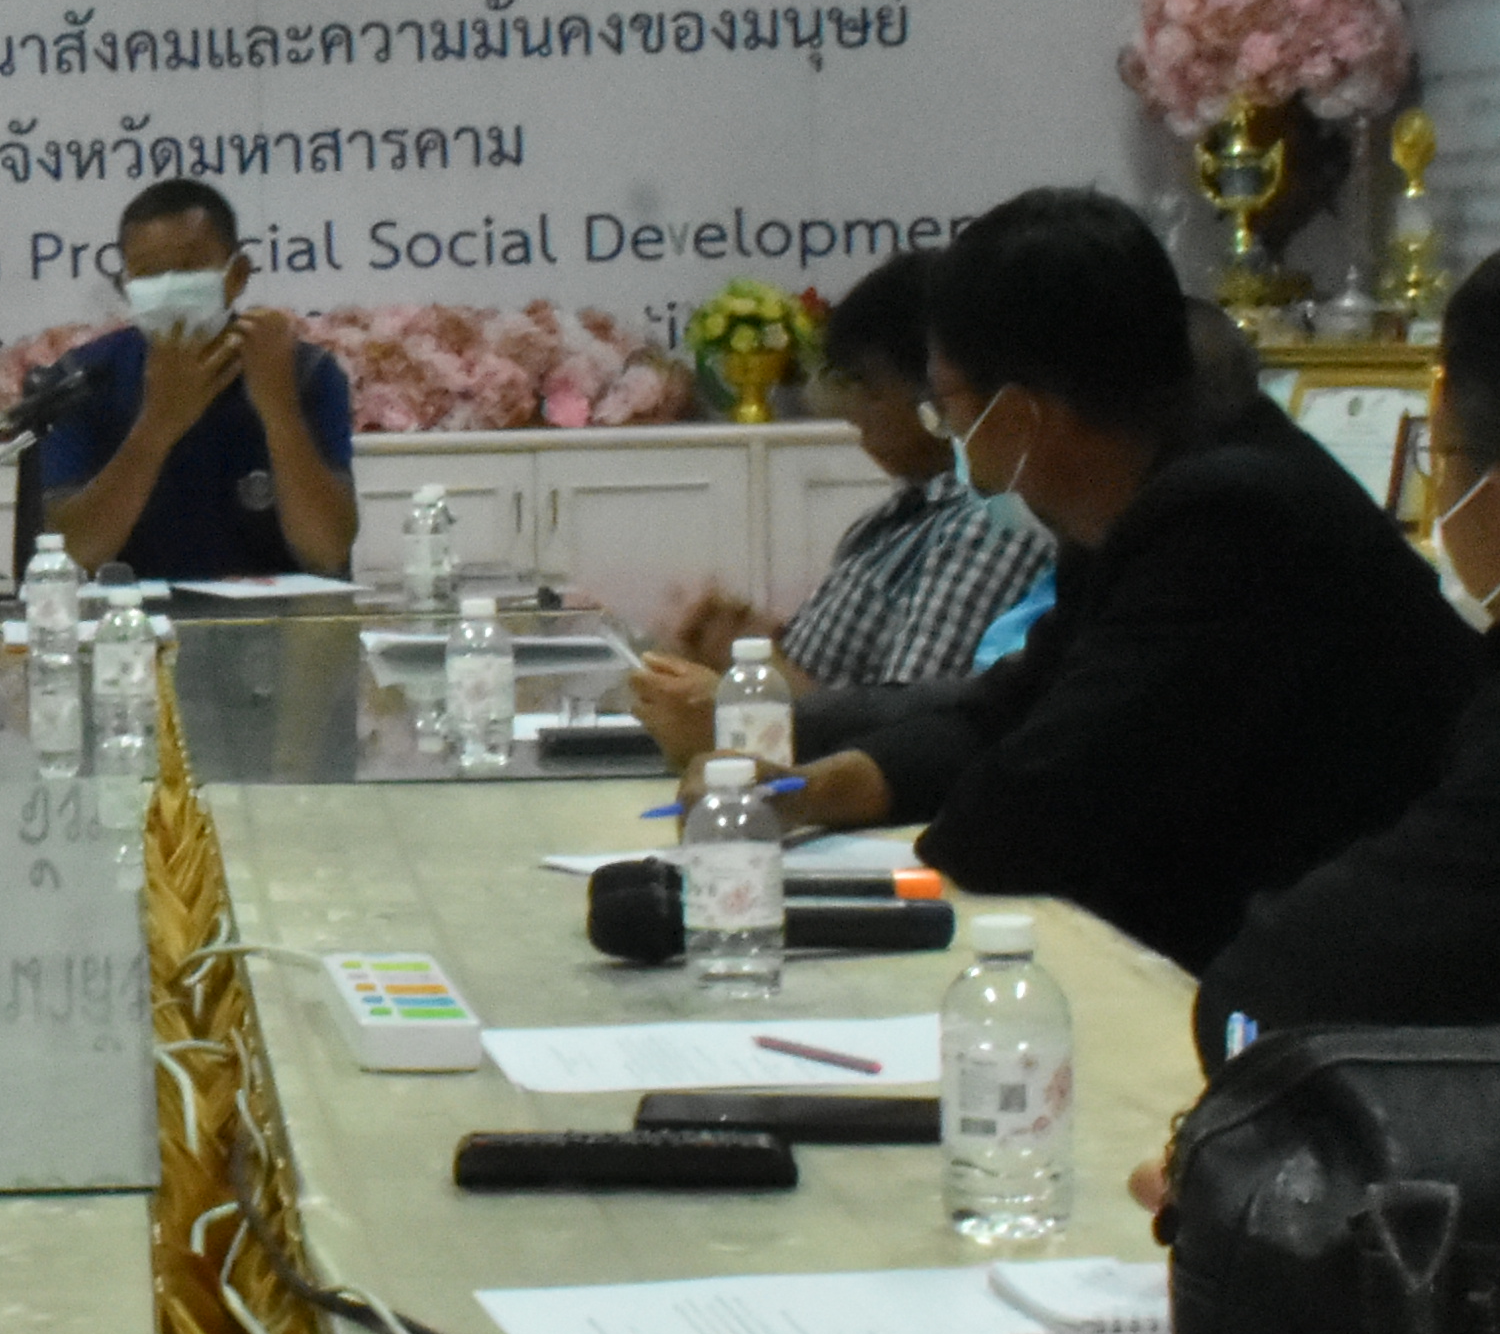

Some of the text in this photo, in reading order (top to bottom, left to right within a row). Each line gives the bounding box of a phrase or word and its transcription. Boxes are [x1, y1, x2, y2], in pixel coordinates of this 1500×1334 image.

[31, 220, 343, 283] Procial
[368, 212, 559, 269] Social
[584, 207, 980, 269] Developme
